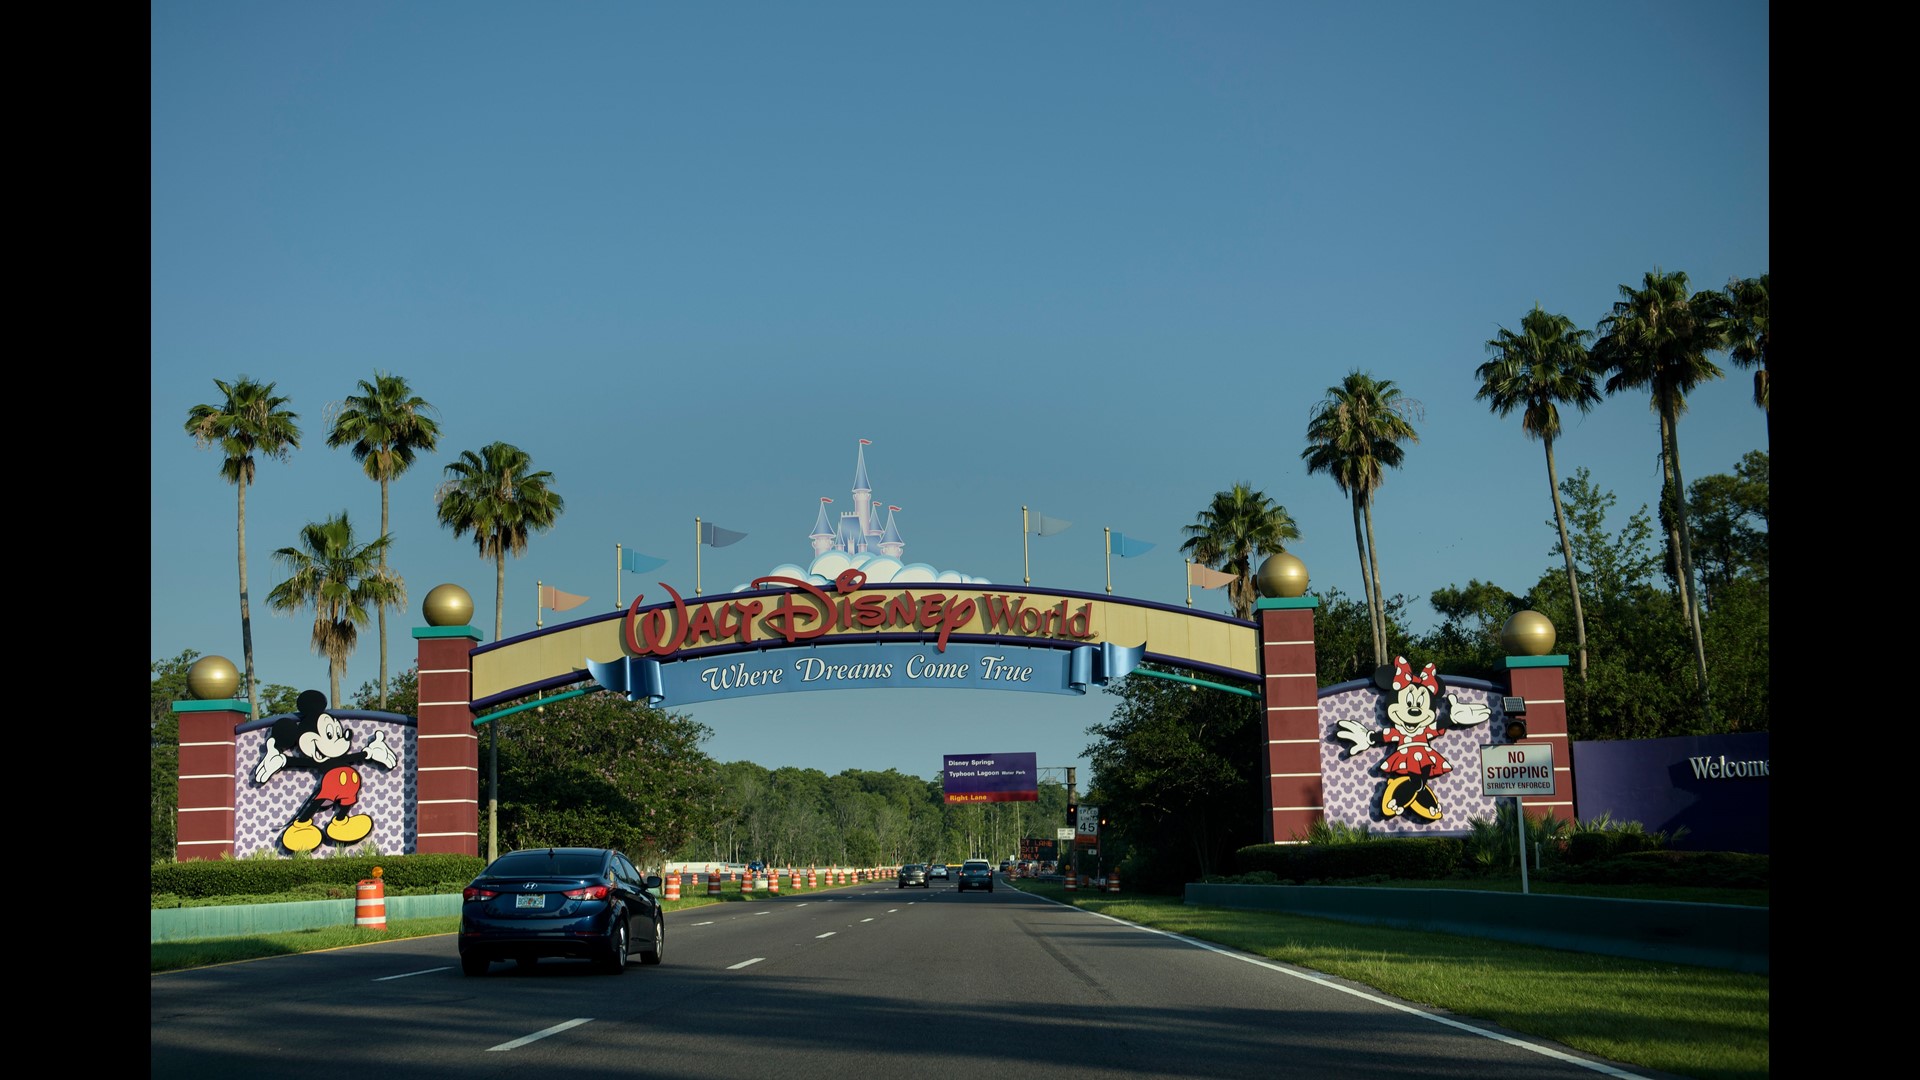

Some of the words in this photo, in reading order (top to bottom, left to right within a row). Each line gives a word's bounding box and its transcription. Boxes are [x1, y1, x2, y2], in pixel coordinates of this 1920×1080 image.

[701, 663, 783, 691] Where
[795, 657, 893, 683] Dreams
[906, 654, 969, 680] Come
[980, 655, 1033, 682] True
[1508, 751, 1525, 763] NO
[1487, 765, 1548, 779] STOPPING
[1517, 781, 1550, 789] ENFORCED
[1080, 822, 1095, 832] 45
